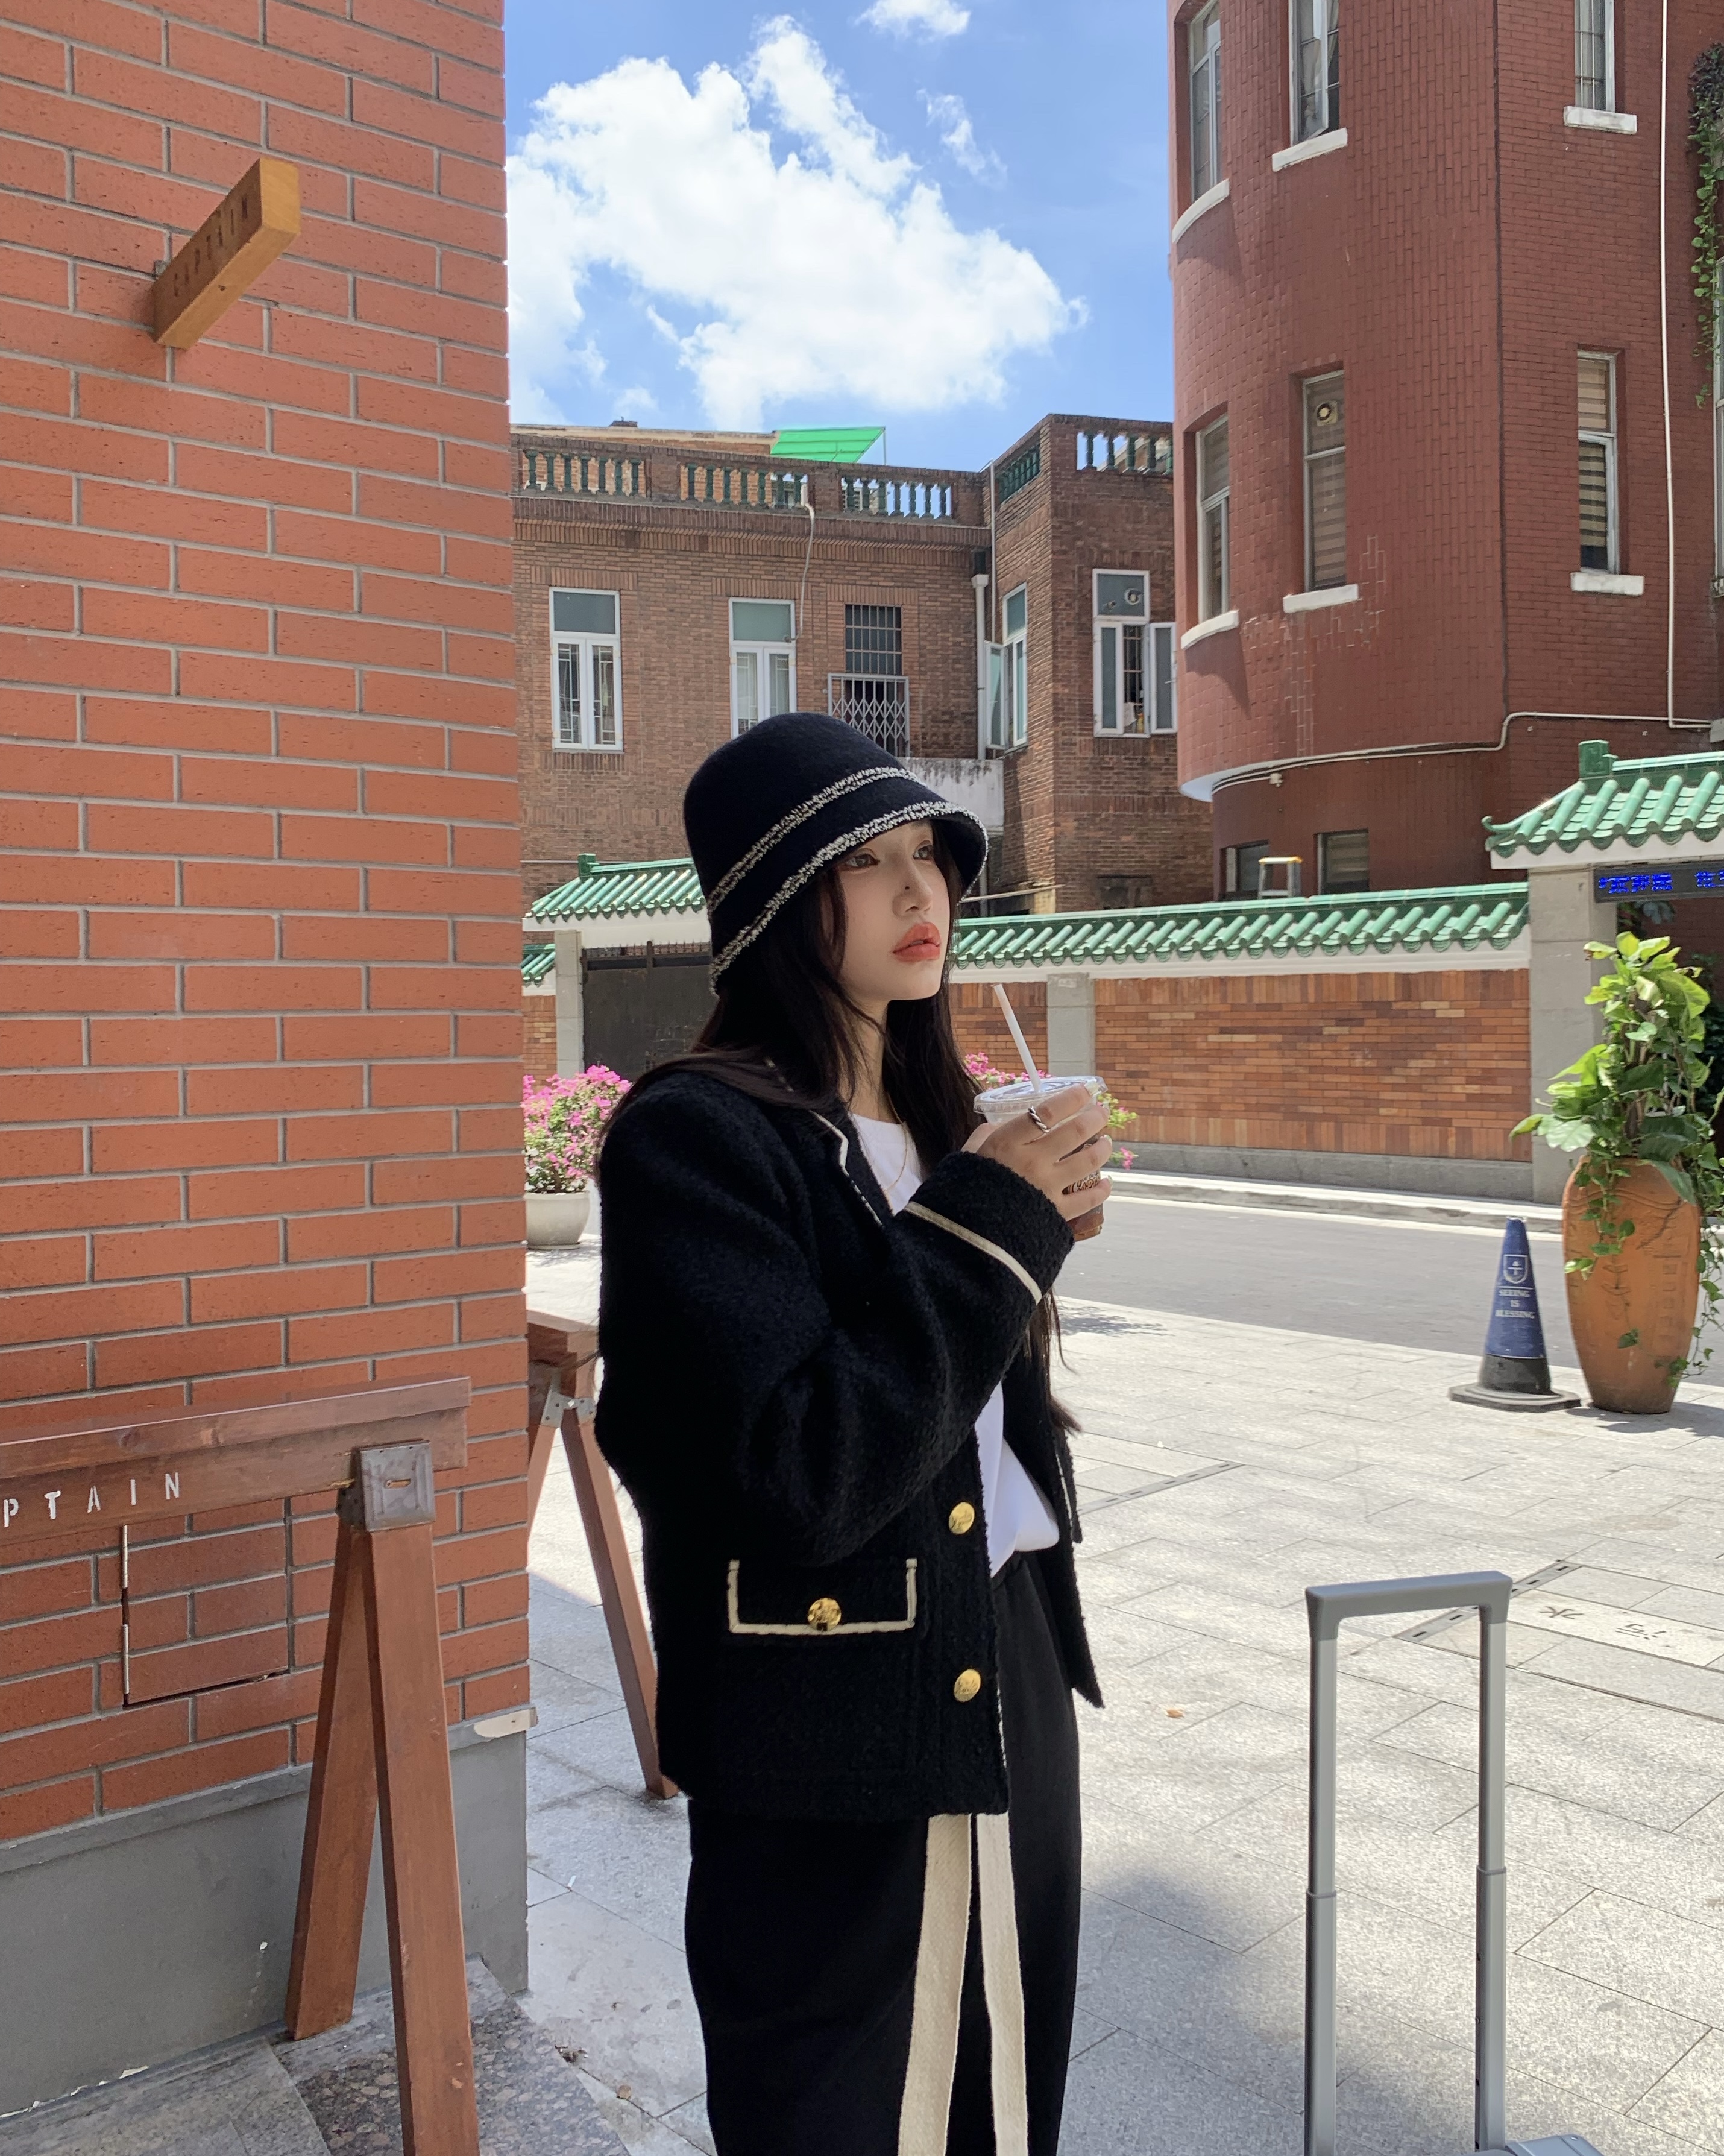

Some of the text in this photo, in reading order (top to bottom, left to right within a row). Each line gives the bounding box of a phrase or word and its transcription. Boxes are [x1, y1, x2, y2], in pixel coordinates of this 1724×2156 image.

[1499, 1289, 1530, 1297] SEEING
[1495, 1310, 1535, 1319] BLESSING
[4, 1472, 180, 1528] PTAIN
